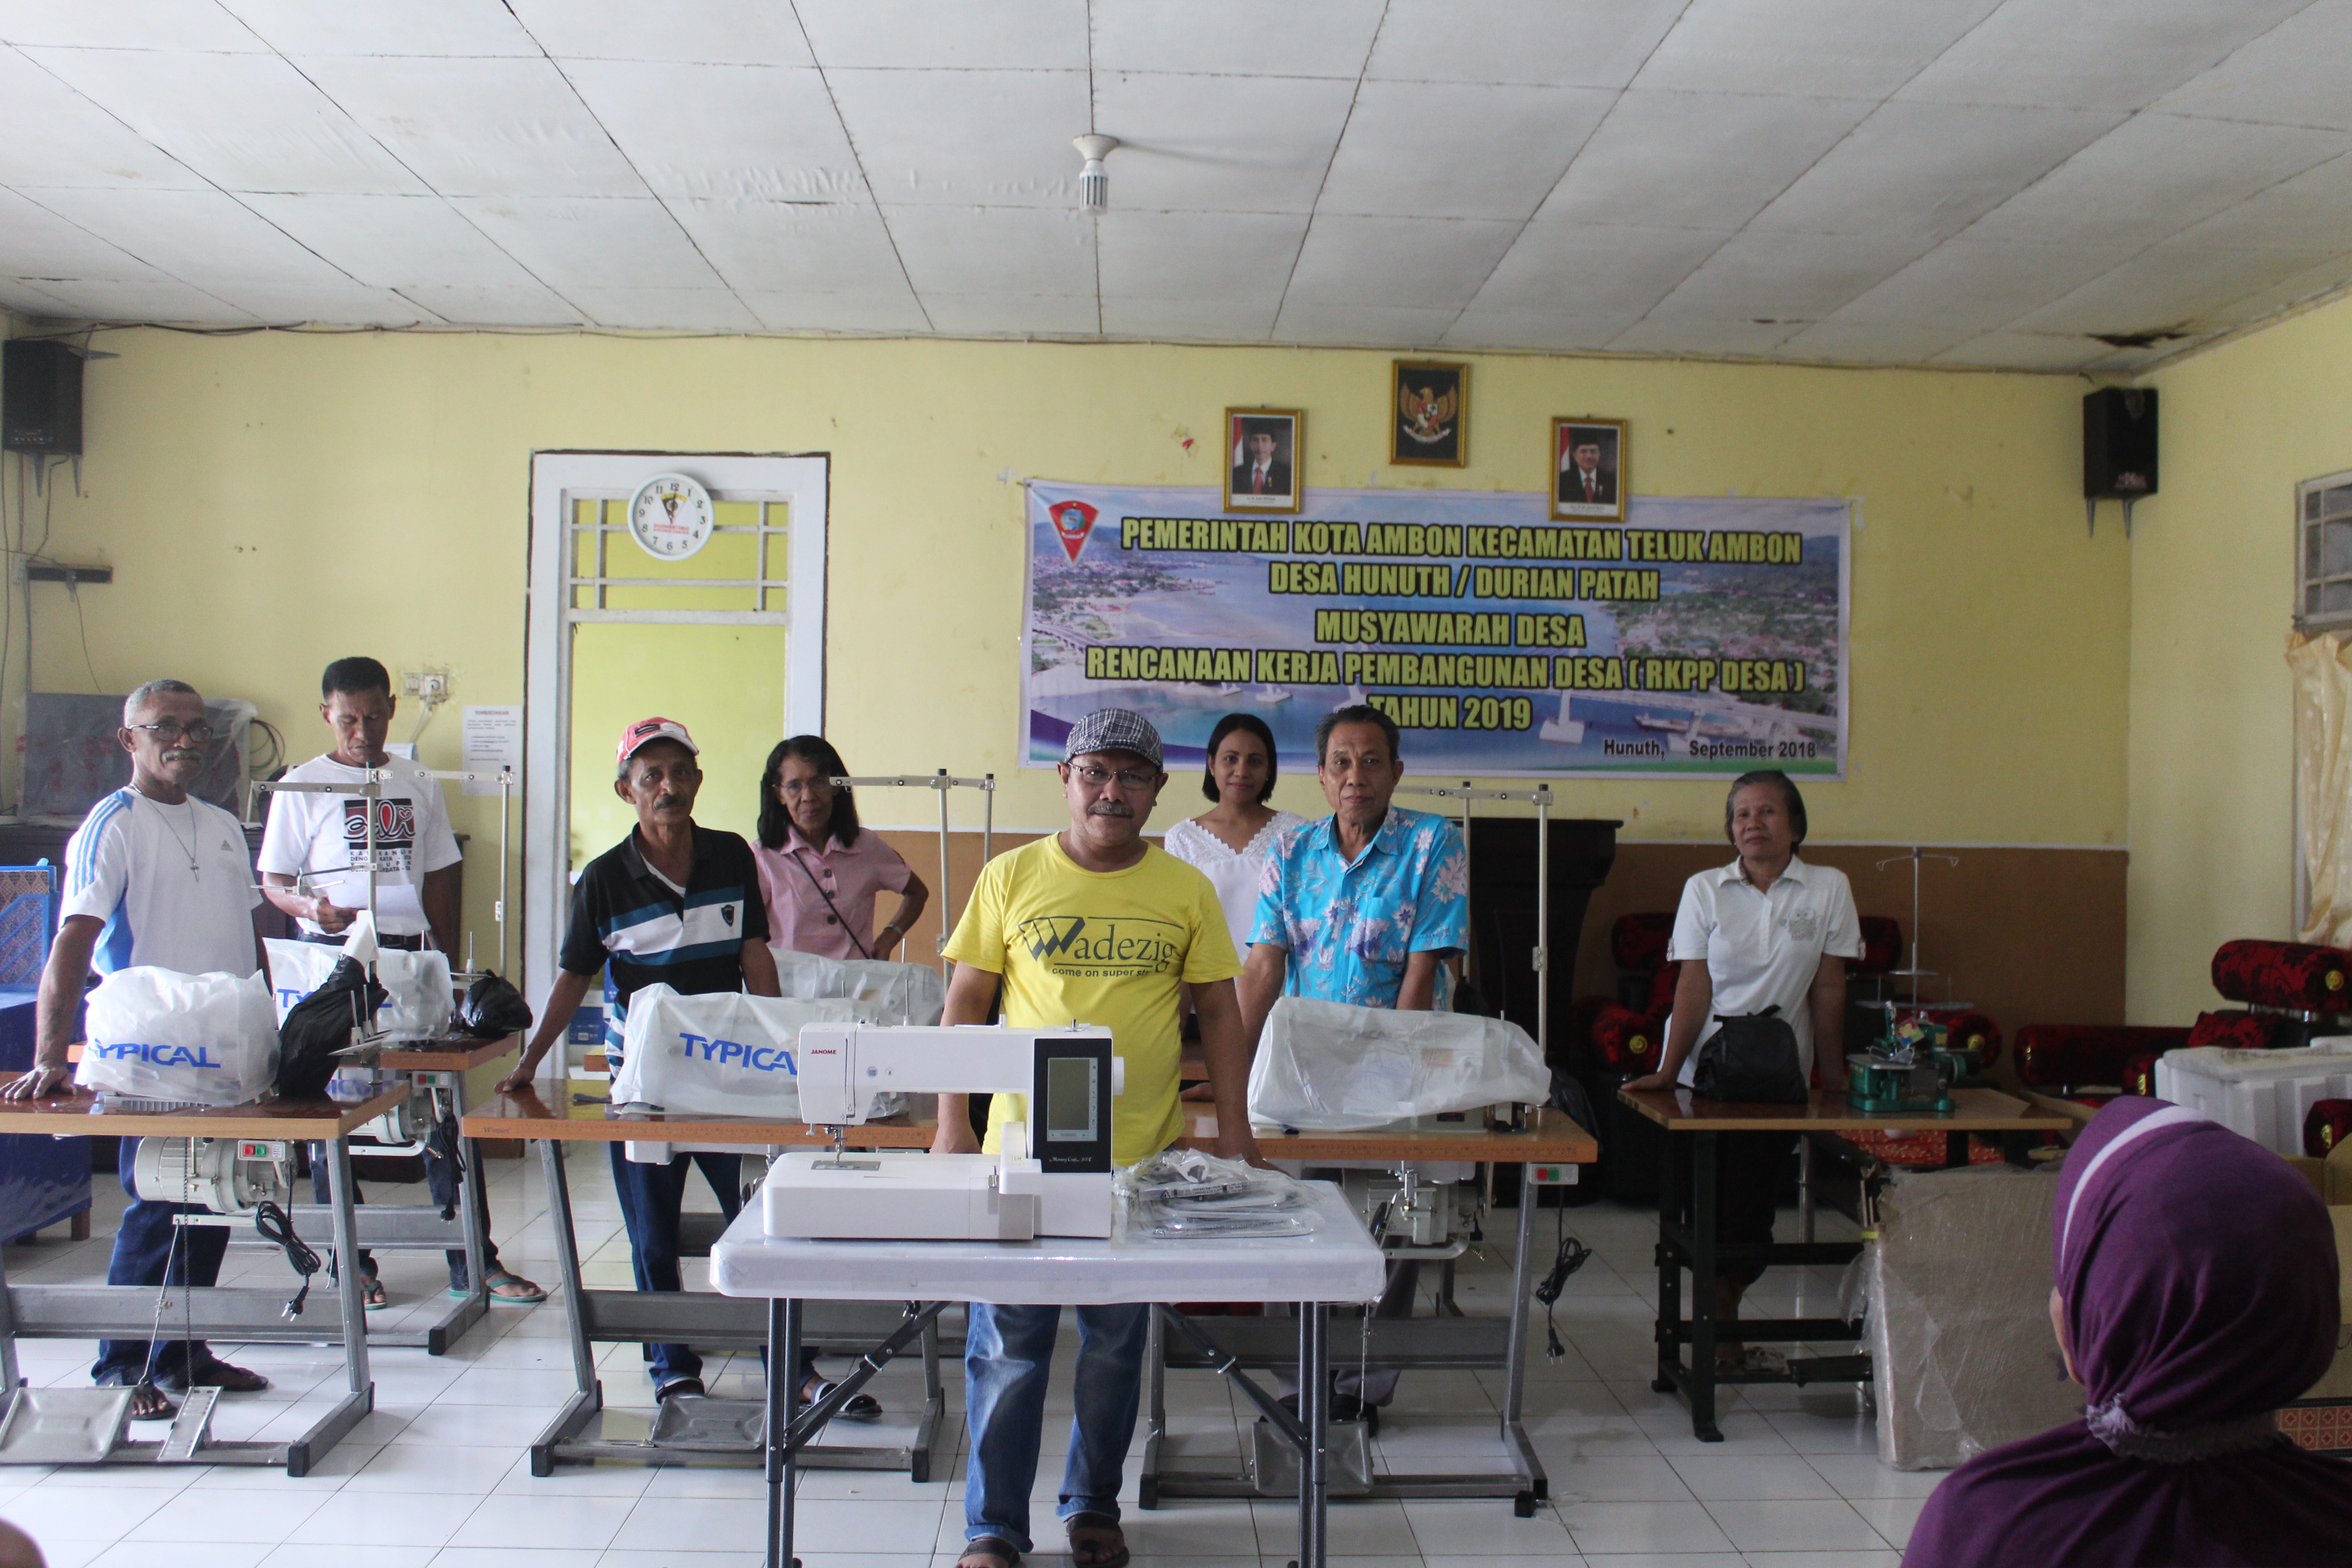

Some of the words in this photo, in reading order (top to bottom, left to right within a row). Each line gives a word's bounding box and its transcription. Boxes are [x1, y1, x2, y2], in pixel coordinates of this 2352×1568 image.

[687, 489, 691, 497] 1
[697, 500, 703, 508] 2
[667, 542, 672, 550] 6
[693, 530, 698, 539] 4
[1121, 517, 1289, 553] PEMERINTAH
[1292, 521, 1362, 555] KOTA
[1364, 523, 1463, 557] AMBON
[1466, 525, 1623, 561] KECAMATAN
[1625, 529, 1706, 563] TELUK
[1707, 532, 1802, 564] AMBON
[1269, 561, 1340, 595] DESA
[1342, 563, 1451, 597] HUNUTH
[1454, 564, 1471, 598] /
[1474, 566, 1575, 599] DURIAN
[1578, 568, 1660, 601] PATAH
[1315, 609, 1511, 646] MUSYAWARAH
[1514, 612, 1586, 647] DESA
[1086, 645, 1252, 682] RENCANAAN
[1255, 649, 1340, 685] KERJA
[1343, 652, 1549, 689] PEMBANGUNAN
[1553, 656, 1624, 690] DESA
[1367, 694, 1459, 730] TAHUN
[1461, 696, 1532, 731] 2019
[1603, 739, 1666, 760] Hunuth,
[1689, 740, 1774, 760] September
[1779, 741, 1816, 758] 2018
[1018, 916, 1178, 973] Wadezig
[1052, 967, 1082, 977] come
[1102, 969, 1134, 977] super
[679, 1032, 798, 1075] TYPICA
